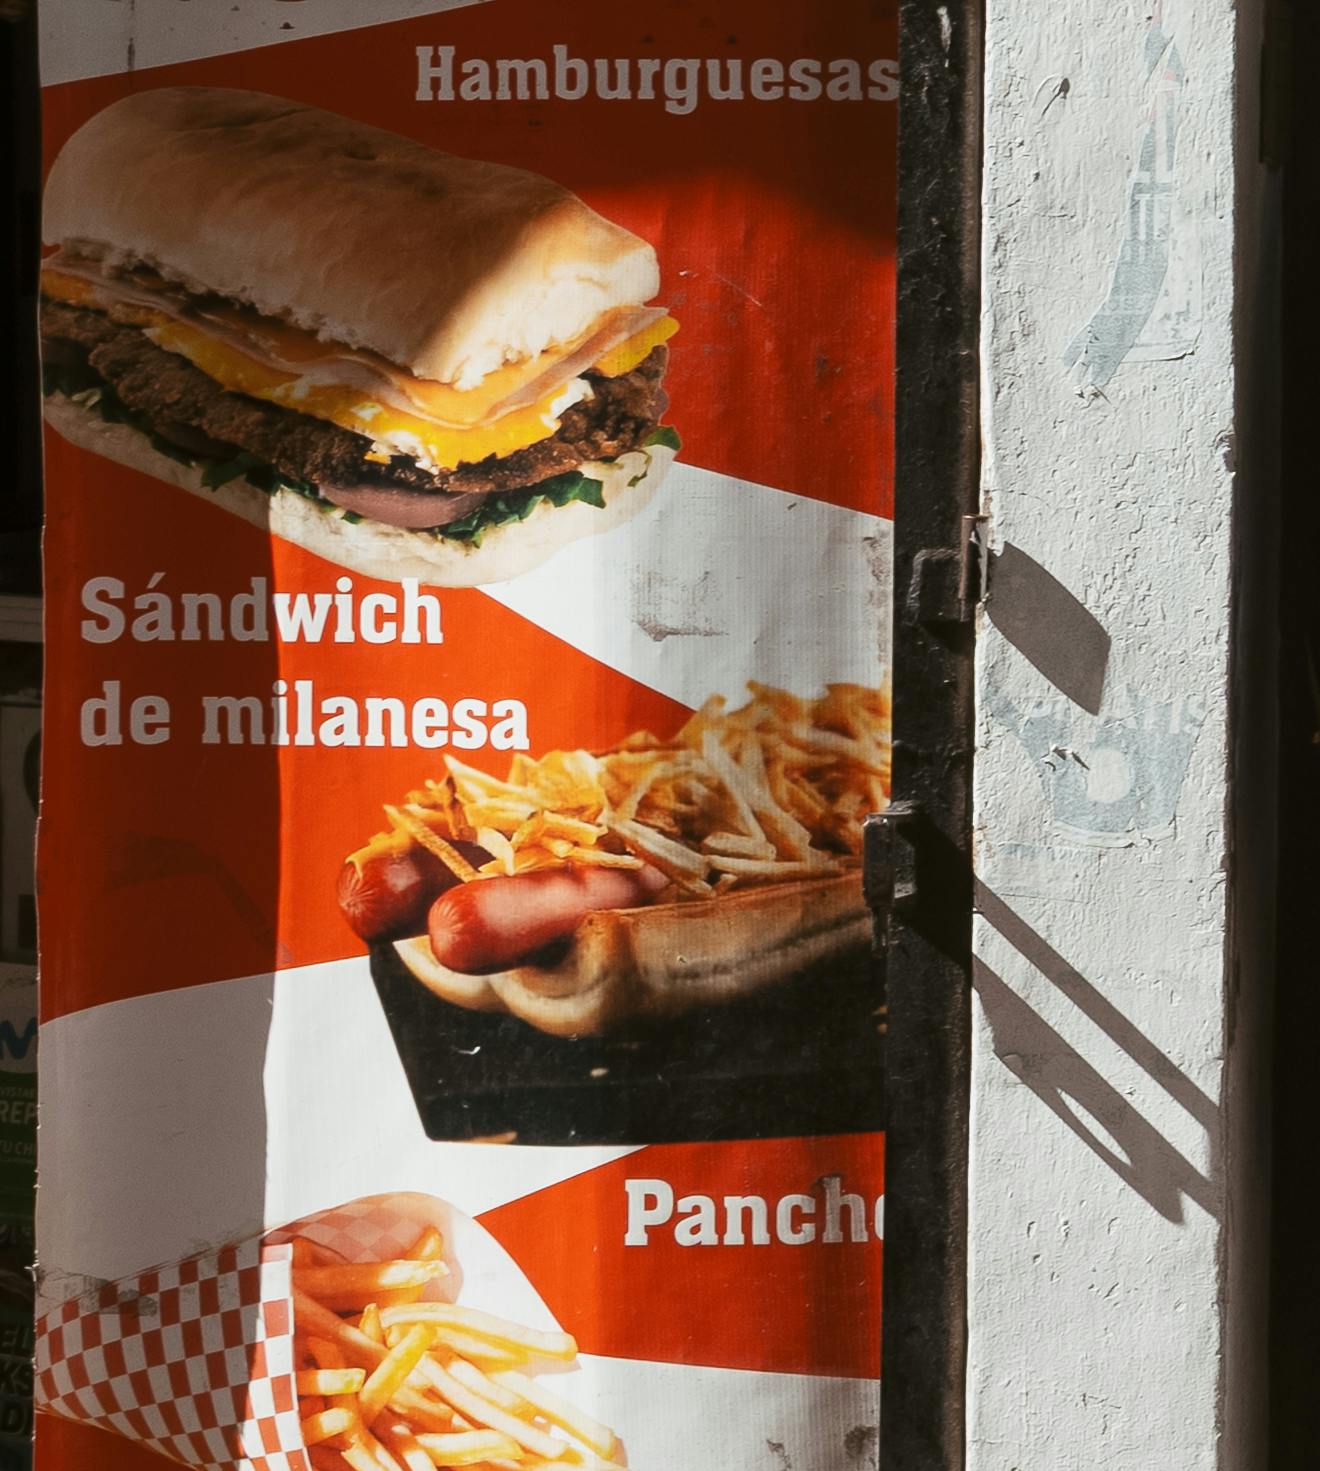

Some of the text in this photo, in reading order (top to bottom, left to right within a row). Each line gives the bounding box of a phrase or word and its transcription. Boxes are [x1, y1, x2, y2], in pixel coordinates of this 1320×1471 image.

[415, 44, 899, 115] Hamburguesas
[81, 572, 444, 645] Sándwich
[80, 680, 530, 750] de milanesa
[624, 1175, 884, 1247] Panch
